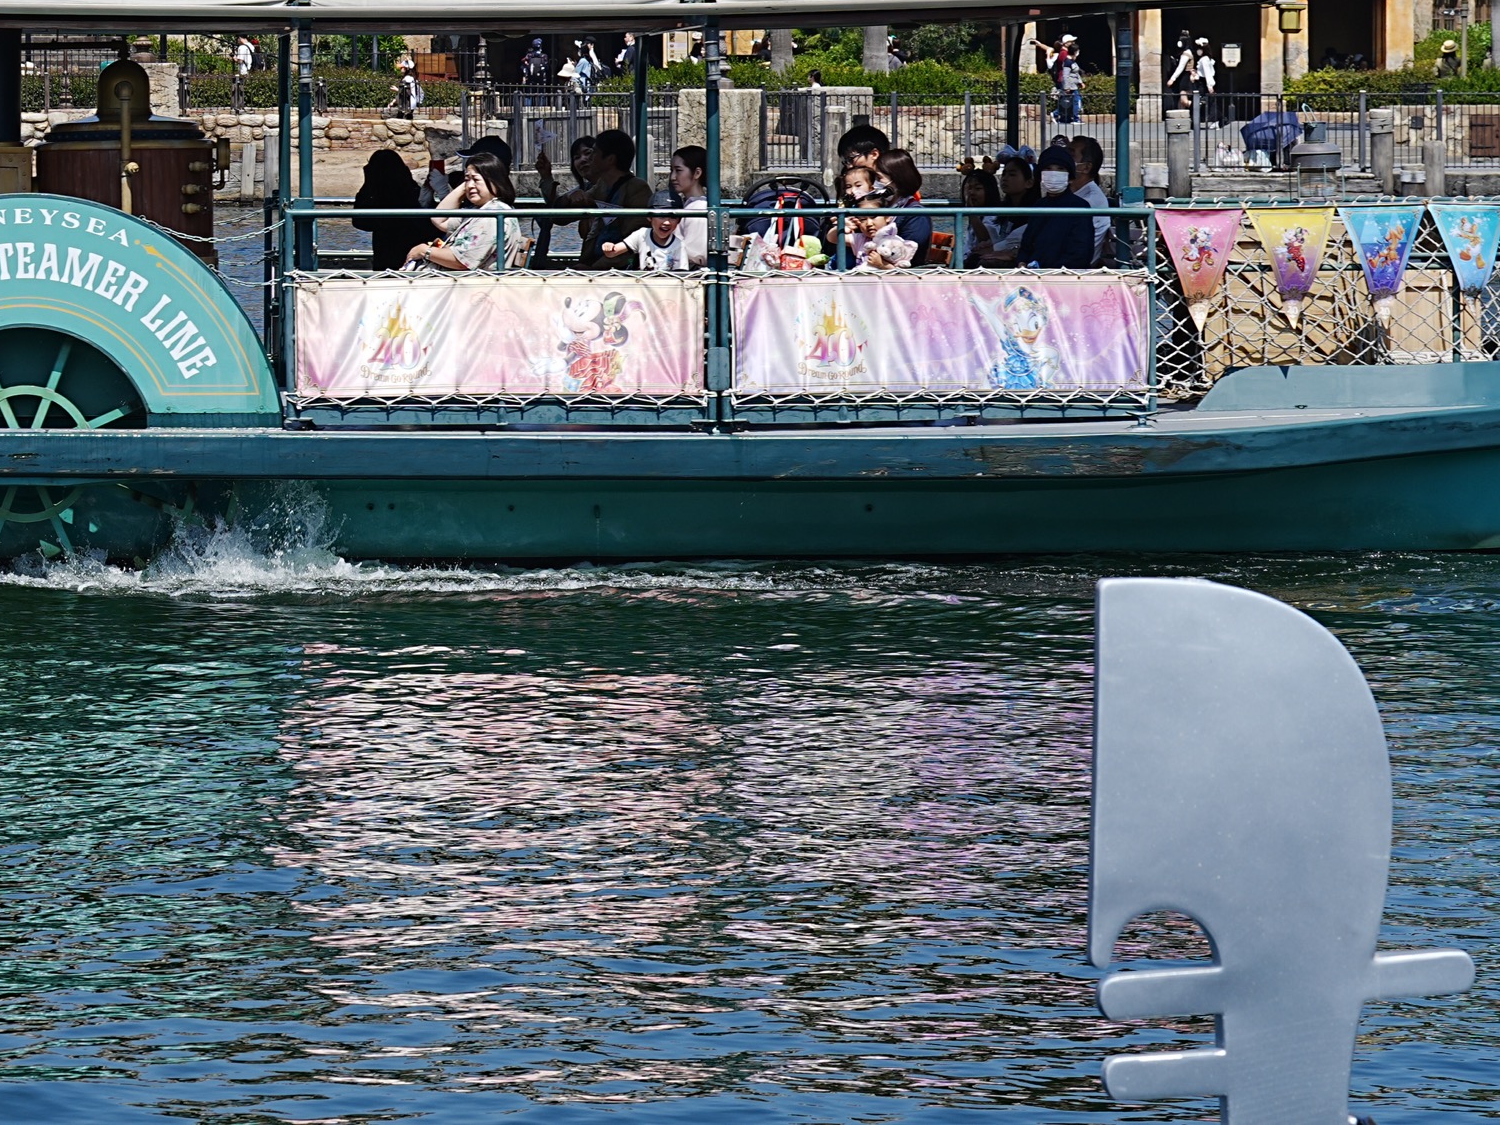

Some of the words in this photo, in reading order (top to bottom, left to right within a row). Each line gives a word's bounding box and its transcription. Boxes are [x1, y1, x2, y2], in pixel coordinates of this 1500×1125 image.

[139, 293, 218, 380] LINE
[367, 327, 421, 371] 40
[804, 325, 856, 368] 40
[360, 365, 389, 383] Dream
[798, 362, 826, 379] Dream
